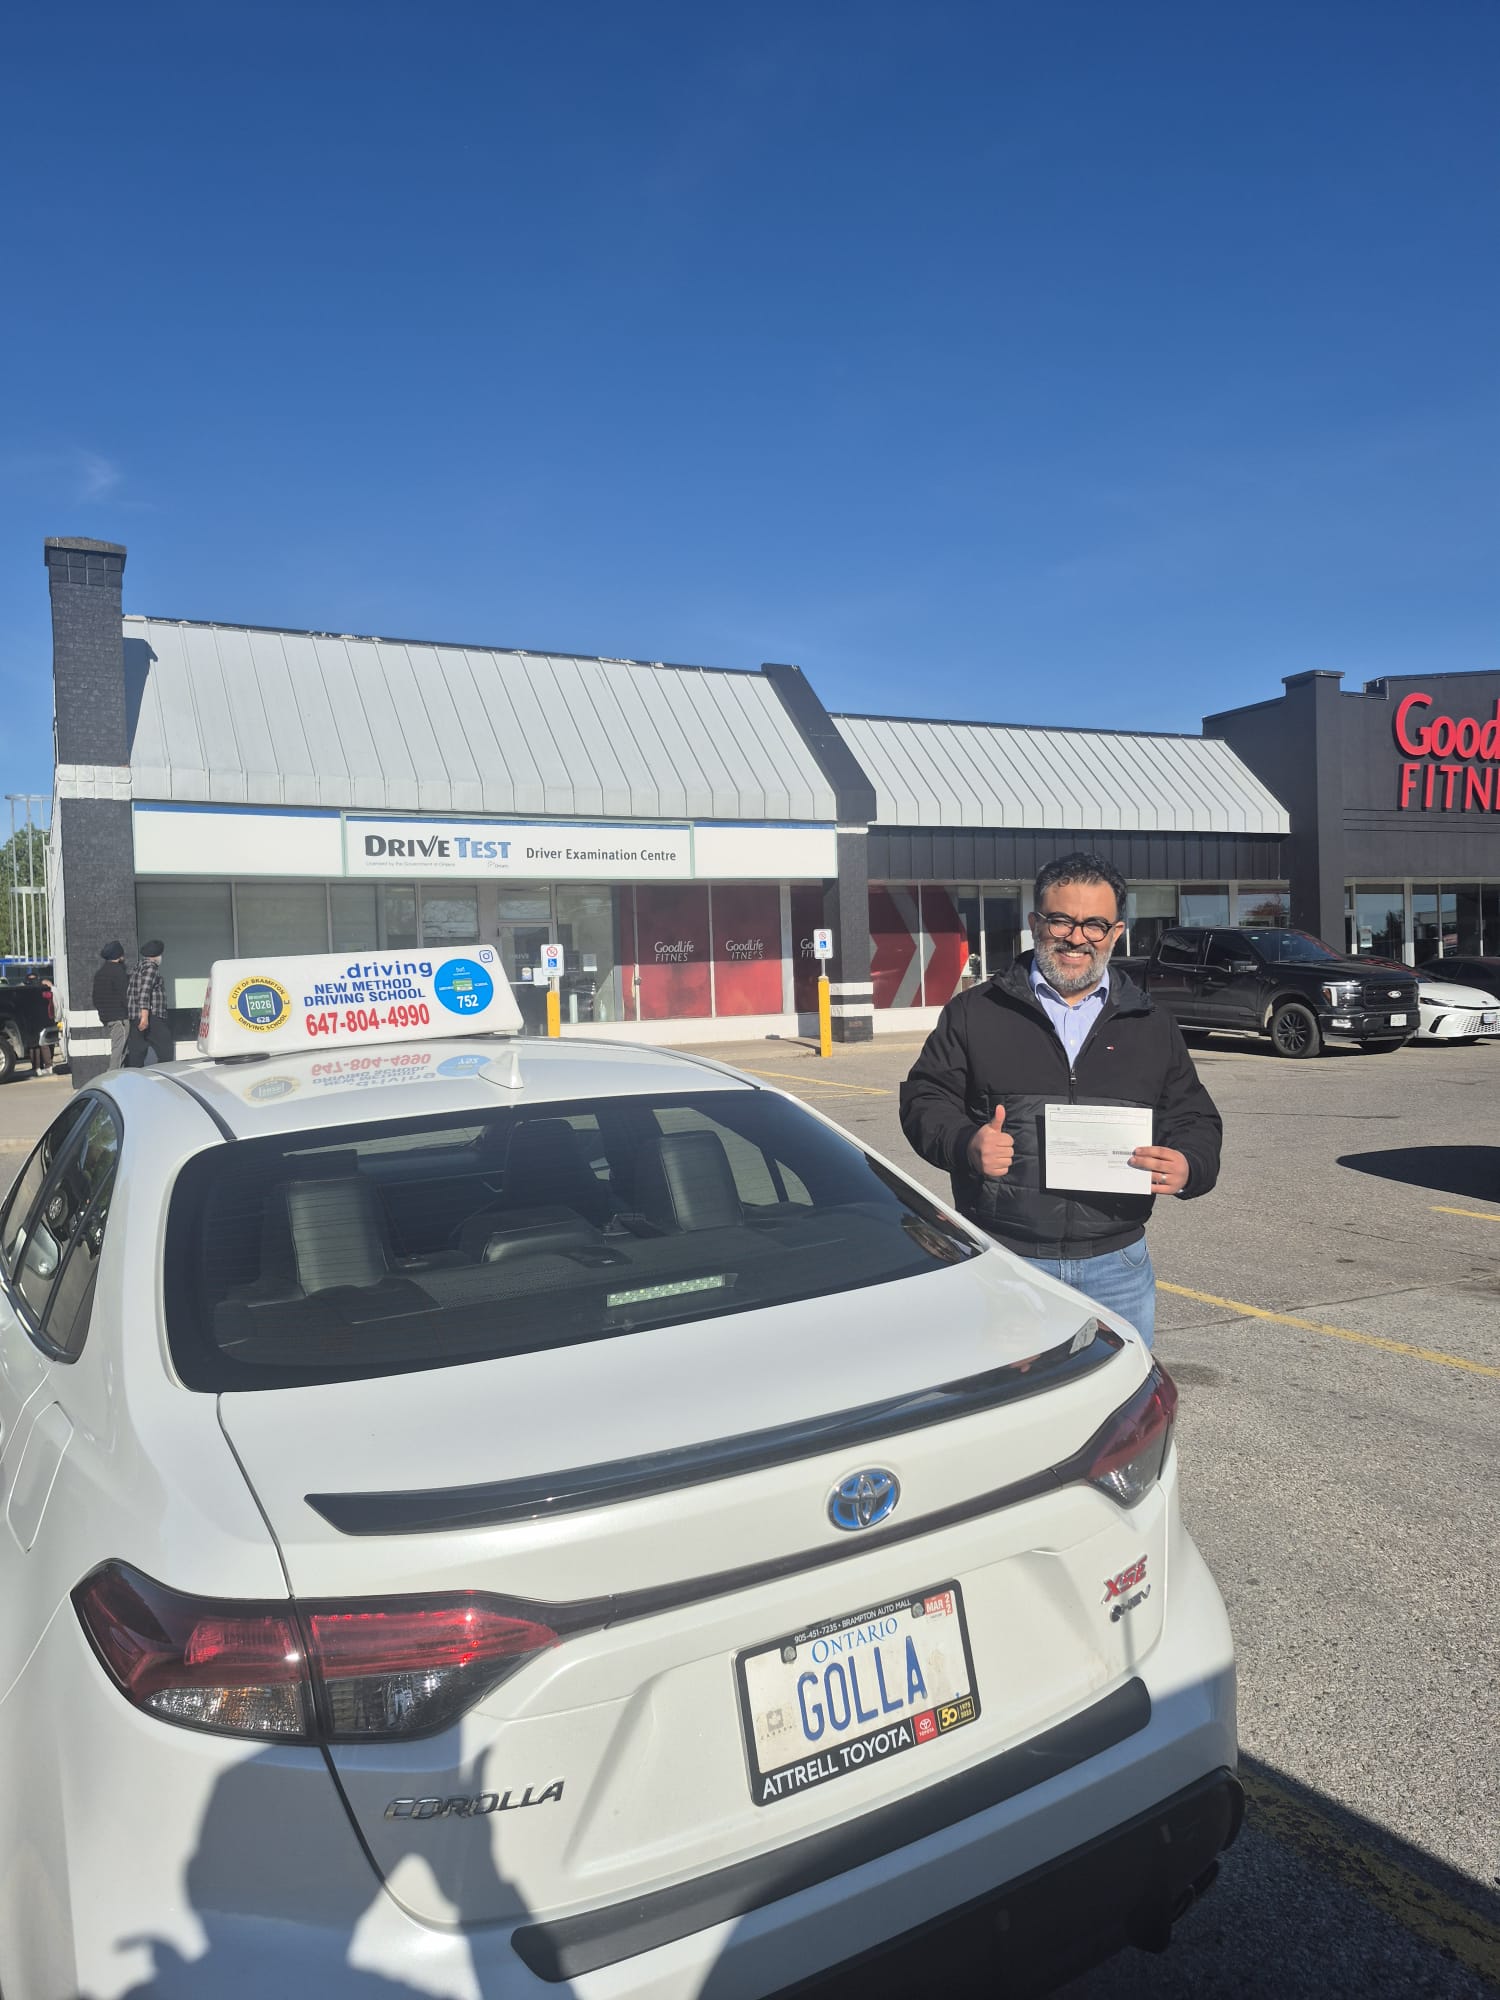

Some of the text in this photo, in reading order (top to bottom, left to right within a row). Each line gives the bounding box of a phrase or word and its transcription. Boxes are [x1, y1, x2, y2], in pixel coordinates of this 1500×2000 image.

[526, 847, 677, 862] Driver Examination Centre
[654, 940, 694, 953] GoodLife
[725, 939, 764, 951] GoodLife
[340, 960, 434, 980] .driving
[231, 986, 243, 999] CITY
[250, 978, 286, 995] BRAMPTON
[314, 978, 412, 995] NEW METHOD
[249, 1000, 272, 1010] 2026
[303, 991, 367, 1007] DRIVING
[369, 987, 426, 1004] SCHOOL
[456, 994, 479, 1009] 752
[238, 1014, 287, 1031] DRIVING SCHOOL
[305, 1003, 431, 1037] 647-804-4990
[926, 1599, 944, 1613] MAR
[794, 1599, 912, 1644] 905-451-7235 BRAMPTON AUTO MALL
[811, 1617, 898, 1663] ONTARIO
[796, 1635, 928, 1742] GOLLA
[941, 1707, 958, 1727] 50
[762, 1725, 912, 1800] ATTRELL TOYOTA
[384, 1778, 565, 1820] COROLLA
